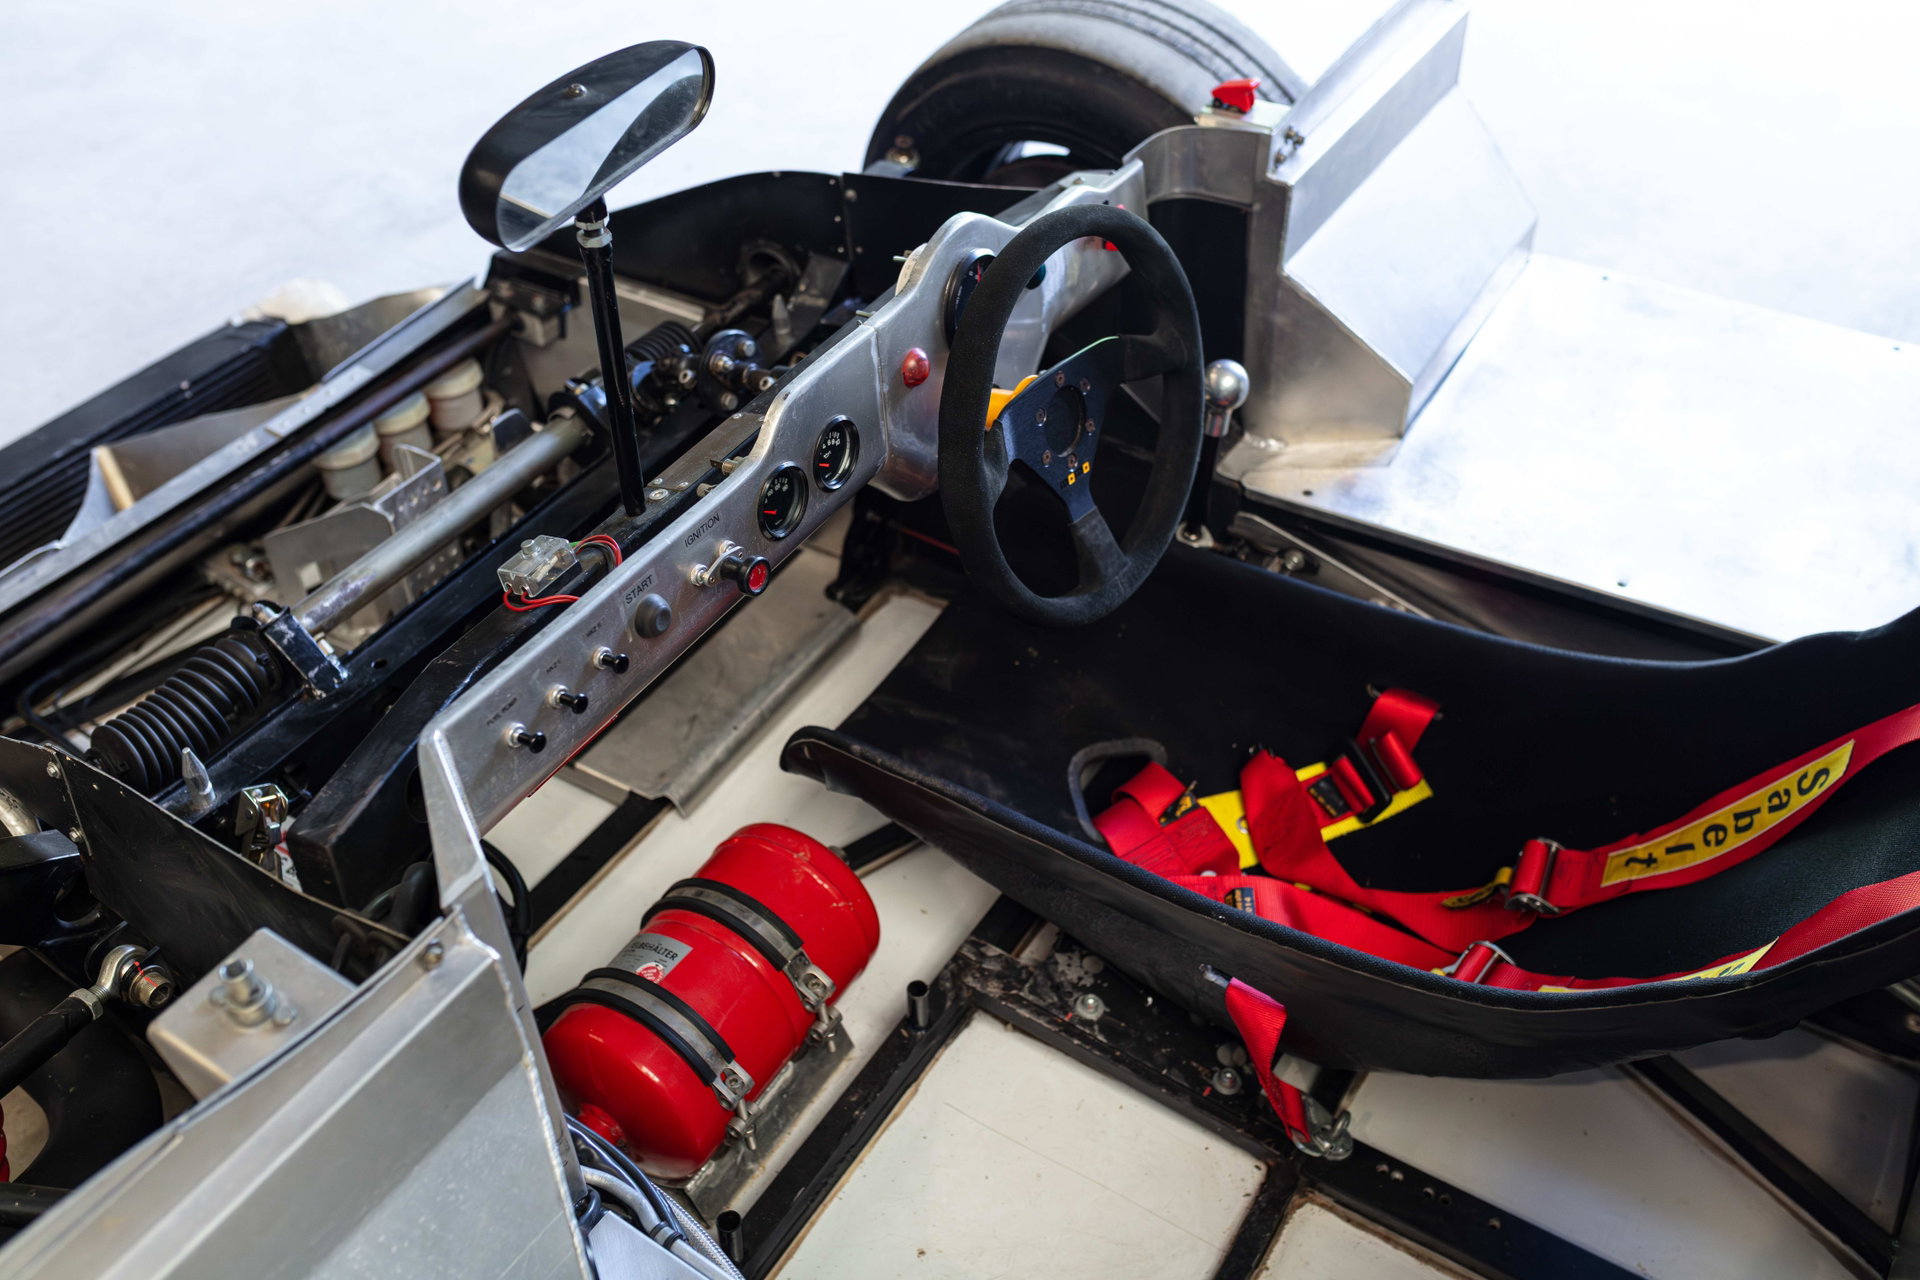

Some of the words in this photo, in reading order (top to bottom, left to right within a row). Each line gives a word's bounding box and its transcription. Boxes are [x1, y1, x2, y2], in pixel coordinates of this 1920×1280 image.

[684, 512, 720, 547] IGNITION
[625, 574, 654, 604] START
[1624, 767, 1830, 869] Sabelt
